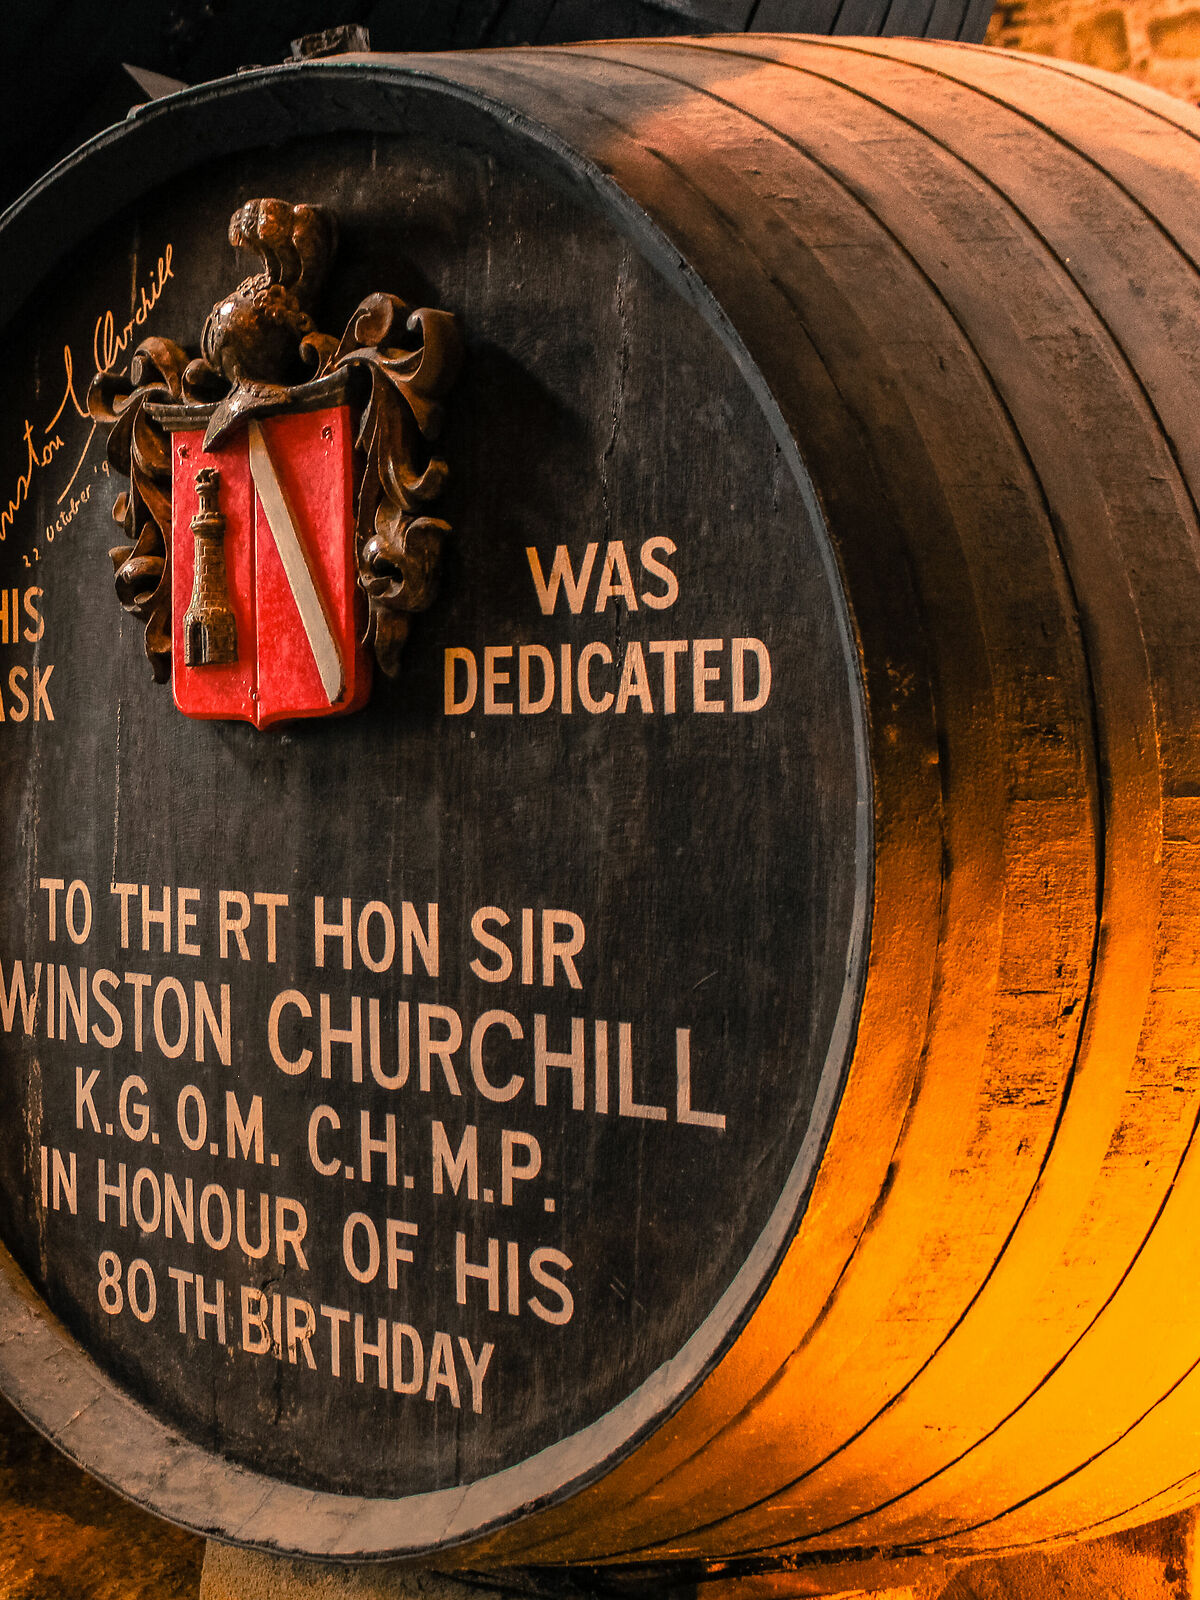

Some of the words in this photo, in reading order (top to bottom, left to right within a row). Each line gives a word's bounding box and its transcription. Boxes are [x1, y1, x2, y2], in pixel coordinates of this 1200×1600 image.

[93, 243, 175, 375] Churchill
[22, 547, 40, 568] 22
[45, 483, 92, 543] October
[526, 535, 679, 615] WAS
[444, 637, 772, 715] DEDICATED
[39, 877, 93, 945] TO
[109, 881, 201, 957] THE
[218, 889, 289, 963] RT
[314, 895, 440, 978] HON
[469, 905, 586, 990] SIR
[267, 989, 727, 1132] CHURCHILL
[75, 1066, 160, 1145] K.G.
[176, 1084, 280, 1167] O.M.
[307, 1104, 415, 1189] C.H.
[431, 1120, 556, 1213] M.P.
[38, 1145, 78, 1215] IN
[97, 1158, 310, 1271] HONOUR
[342, 1212, 419, 1290] OF
[455, 1231, 574, 1326] HIS
[97, 1250, 157, 1323] 80
[168, 1266, 226, 1345] TH
[240, 1285, 495, 1415] BIRTHDAY
